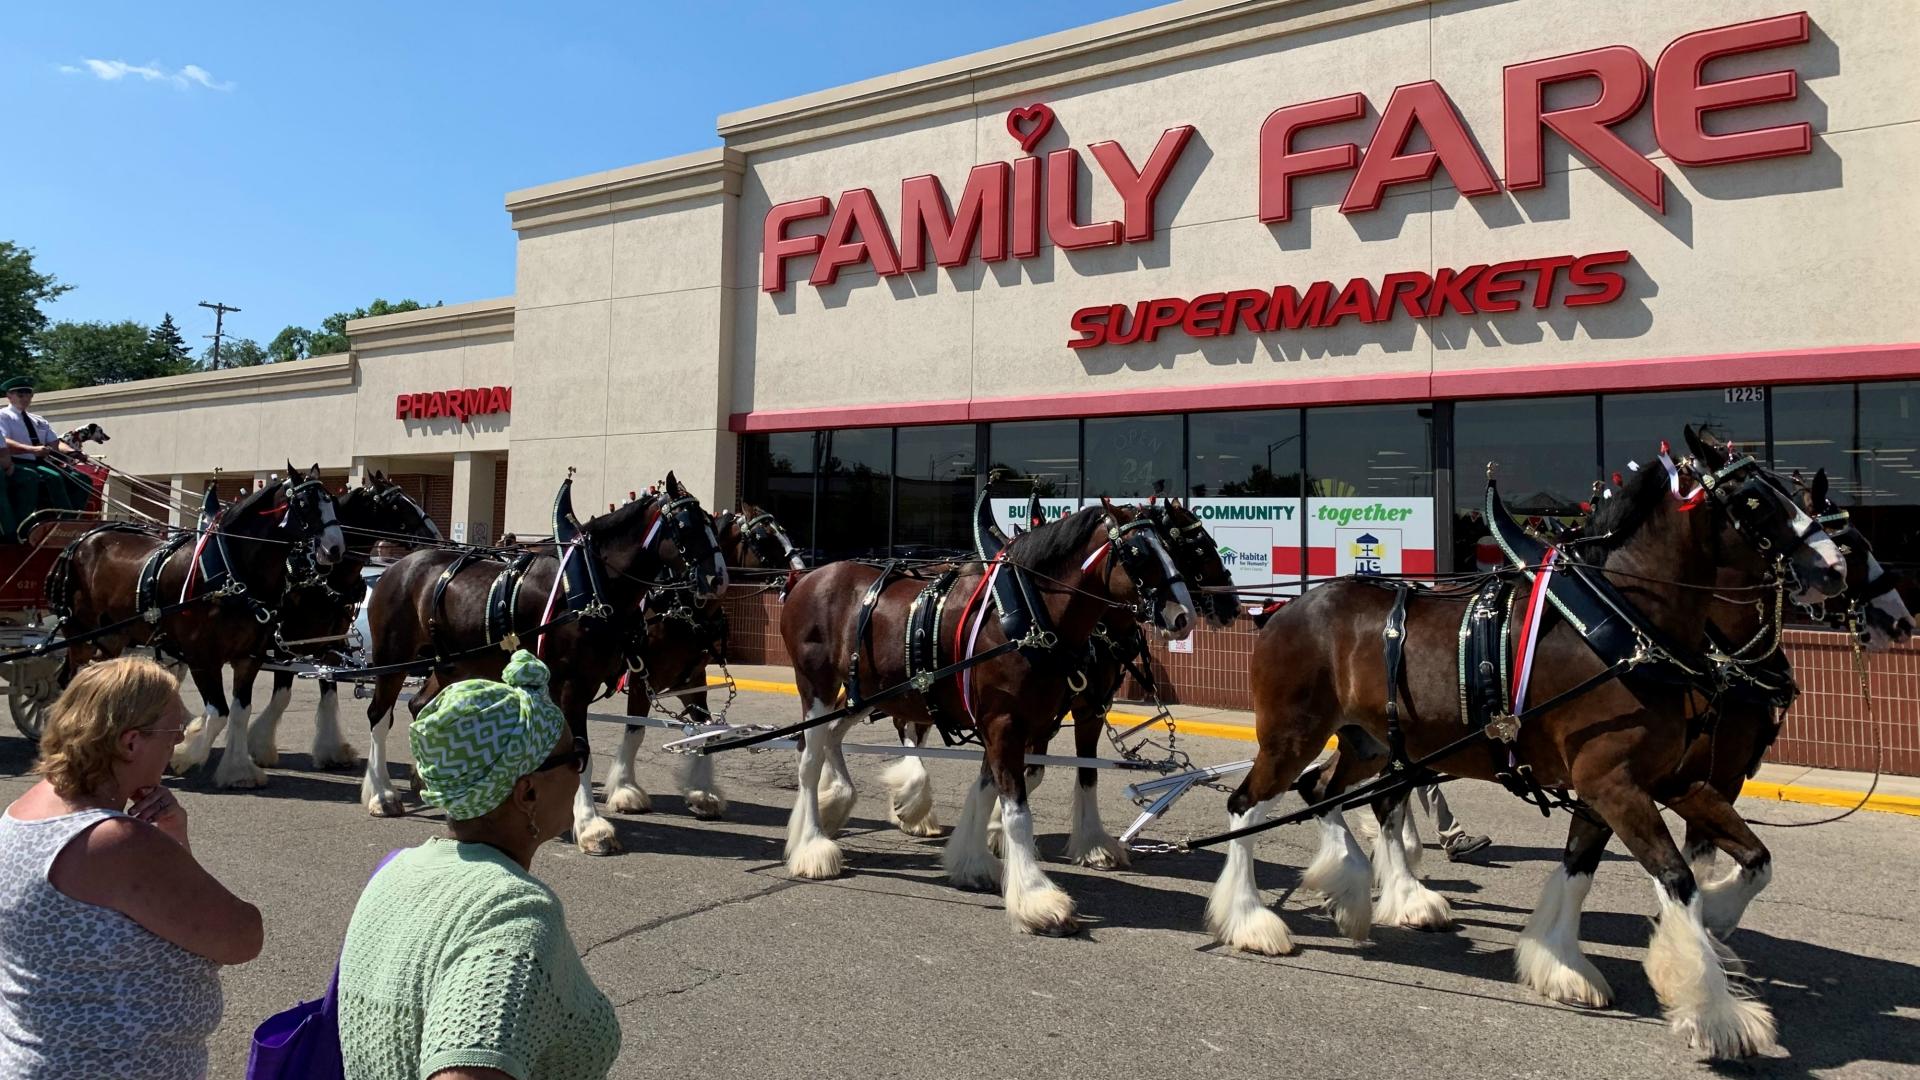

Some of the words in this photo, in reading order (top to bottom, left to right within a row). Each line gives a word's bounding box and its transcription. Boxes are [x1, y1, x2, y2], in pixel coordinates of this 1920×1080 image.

[762, 103, 1196, 293] FAMILY
[1259, 10, 1812, 224] FARE
[1066, 249, 1632, 350] SUPERMARKETS
[1727, 387, 1763, 402] 1225
[1008, 505, 1072, 519] BUDING
[1192, 505, 1295, 520] COMMUNITY
[1318, 503, 1413, 526] together
[1239, 552, 1268, 561] Habitat
